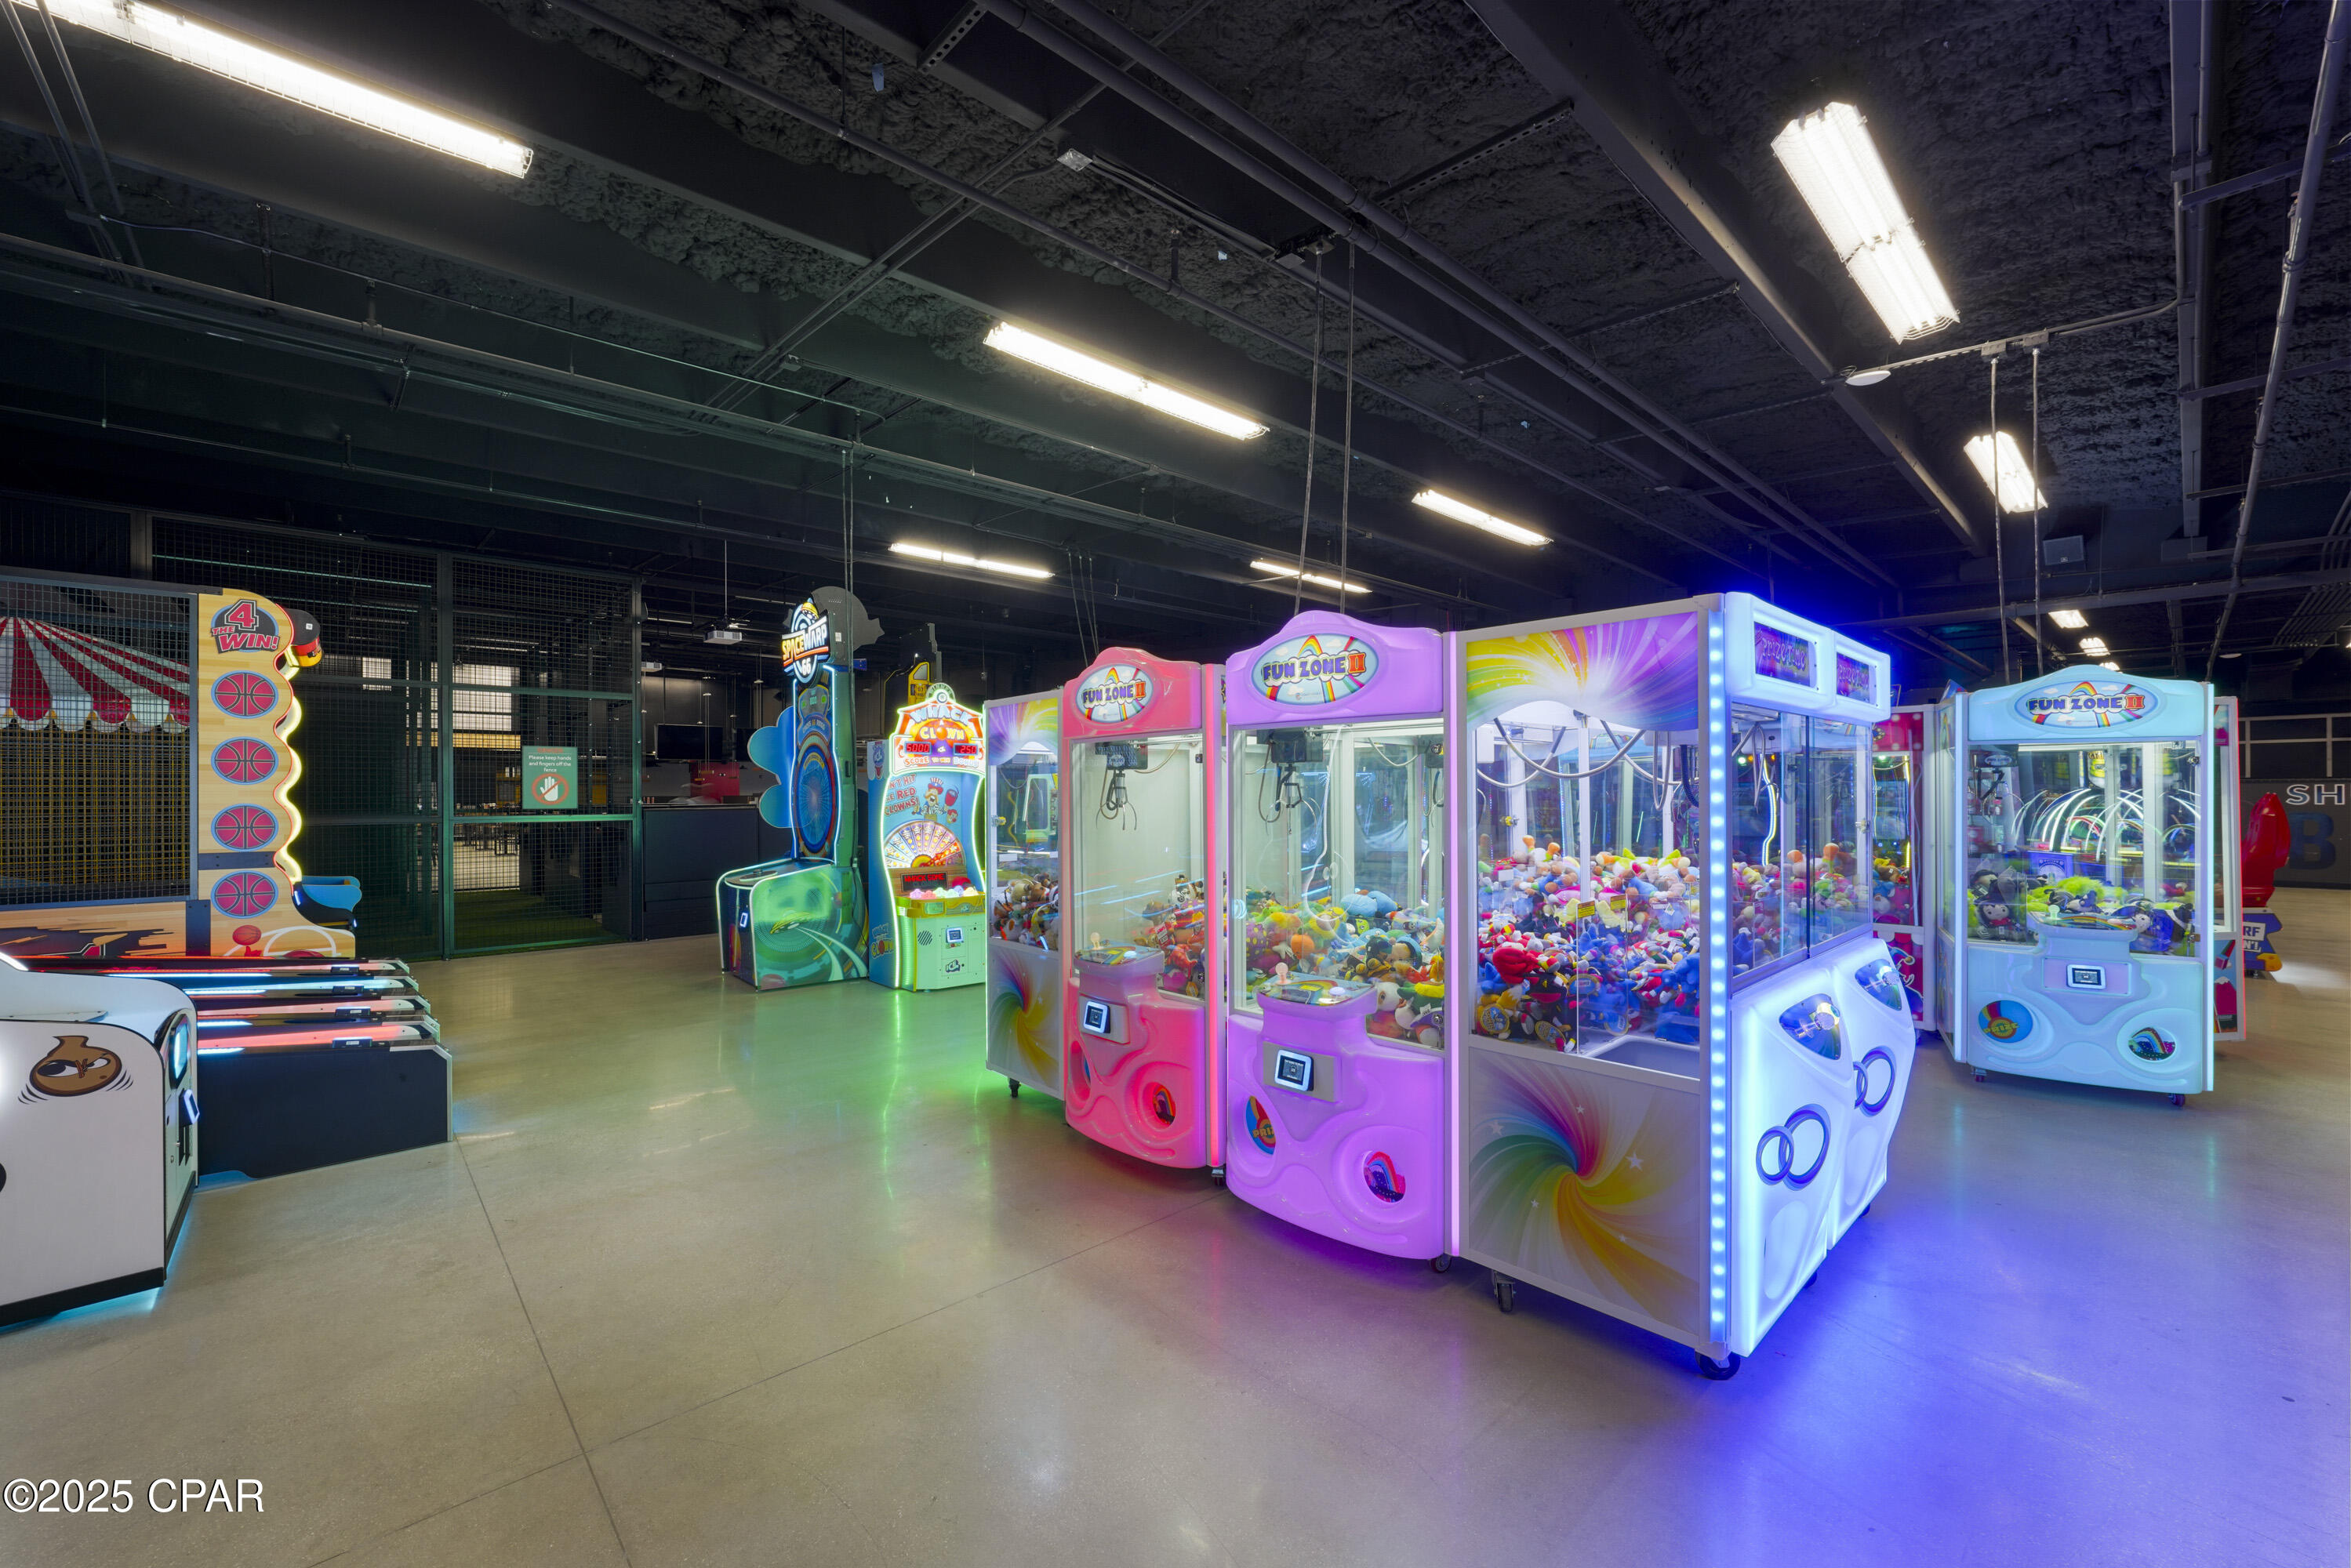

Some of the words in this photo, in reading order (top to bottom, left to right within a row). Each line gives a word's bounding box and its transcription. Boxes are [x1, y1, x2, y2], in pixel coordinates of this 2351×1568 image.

[225, 600, 259, 630] 4
[212, 626, 235, 636] THE
[218, 633, 279, 652] WIN!
[802, 658, 812, 676] 66
[1263, 663, 1295, 681] FUN
[1299, 656, 1346, 677] ZONE
[1348, 653, 1366, 673] II
[1082, 689, 1103, 703] FUN
[1106, 684, 1134, 701] ZONE
[1135, 681, 1146, 698] II
[2029, 699, 2066, 710] FUN
[2071, 697, 2122, 710] ZONE
[2125, 695, 2145, 710] II
[910, 705, 972, 726] WHACK
[919, 727, 965, 740] CLOWN
[906, 742, 930, 753] 5000
[960, 745, 977, 754] 250
[904, 757, 930, 767] SCORE
[888, 779, 901, 789] N'T
[903, 774, 916, 785] HIT
[896, 787, 916, 800] RED
[2286, 784, 2346, 805] SH
